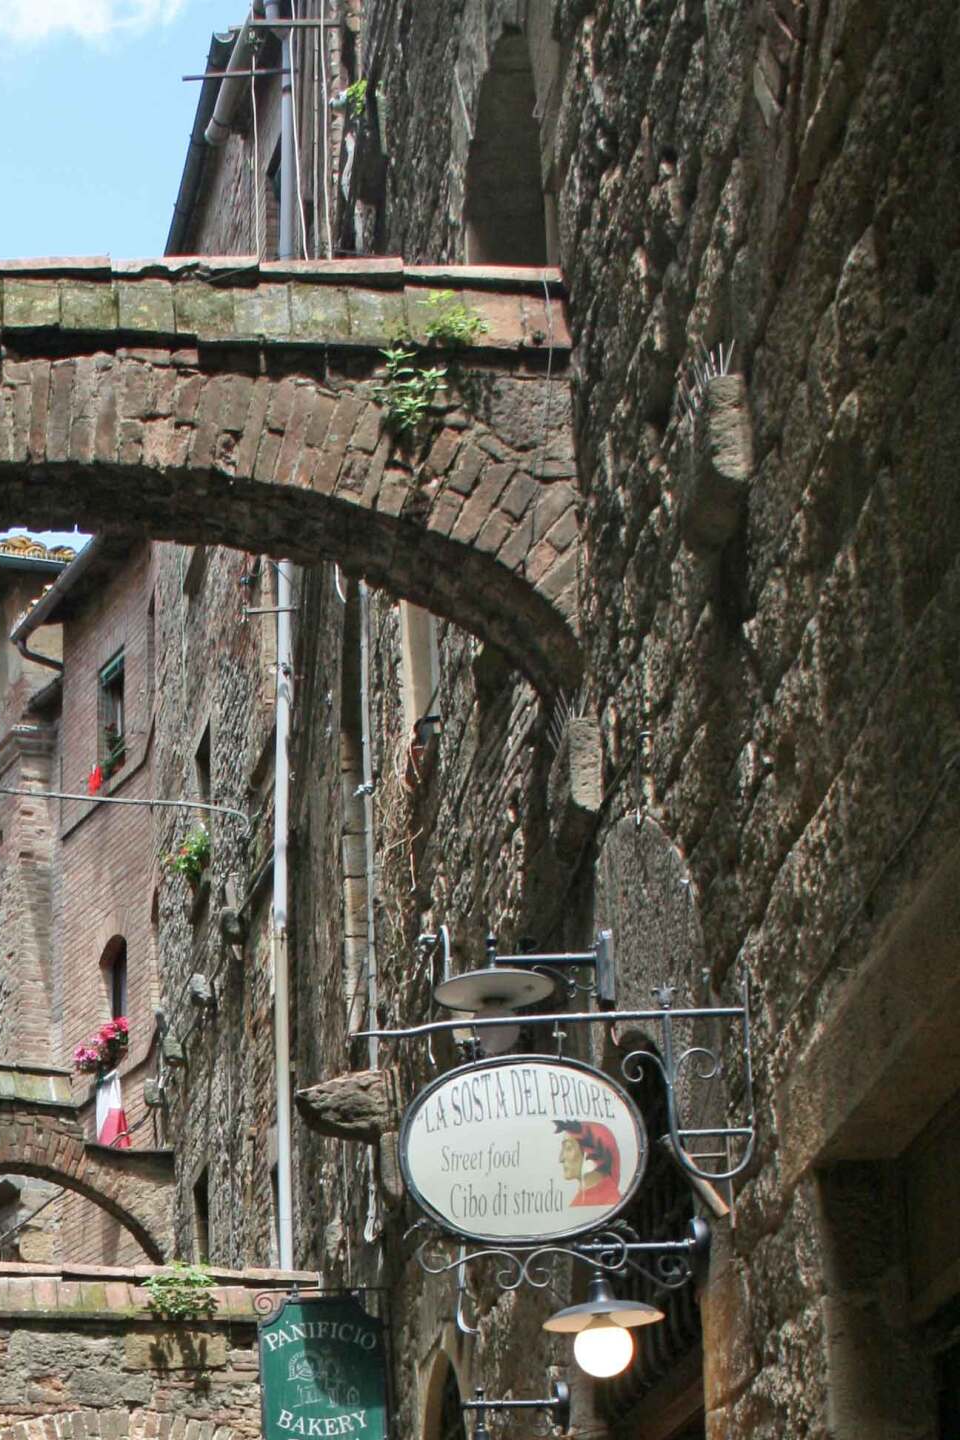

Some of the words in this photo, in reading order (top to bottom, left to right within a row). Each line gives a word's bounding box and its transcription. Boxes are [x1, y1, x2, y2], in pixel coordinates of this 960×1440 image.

[451, 1071, 508, 1127] SOSTA
[510, 1069, 547, 1118] DEL
[441, 1144, 484, 1173] Street
[486, 1141, 521, 1176] food
[450, 1181, 489, 1219] Cibo
[492, 1182, 509, 1217] di
[512, 1178, 564, 1215] strada
[263, 1321, 377, 1352] PANIFICIO
[275, 1408, 368, 1437] BAKERY
